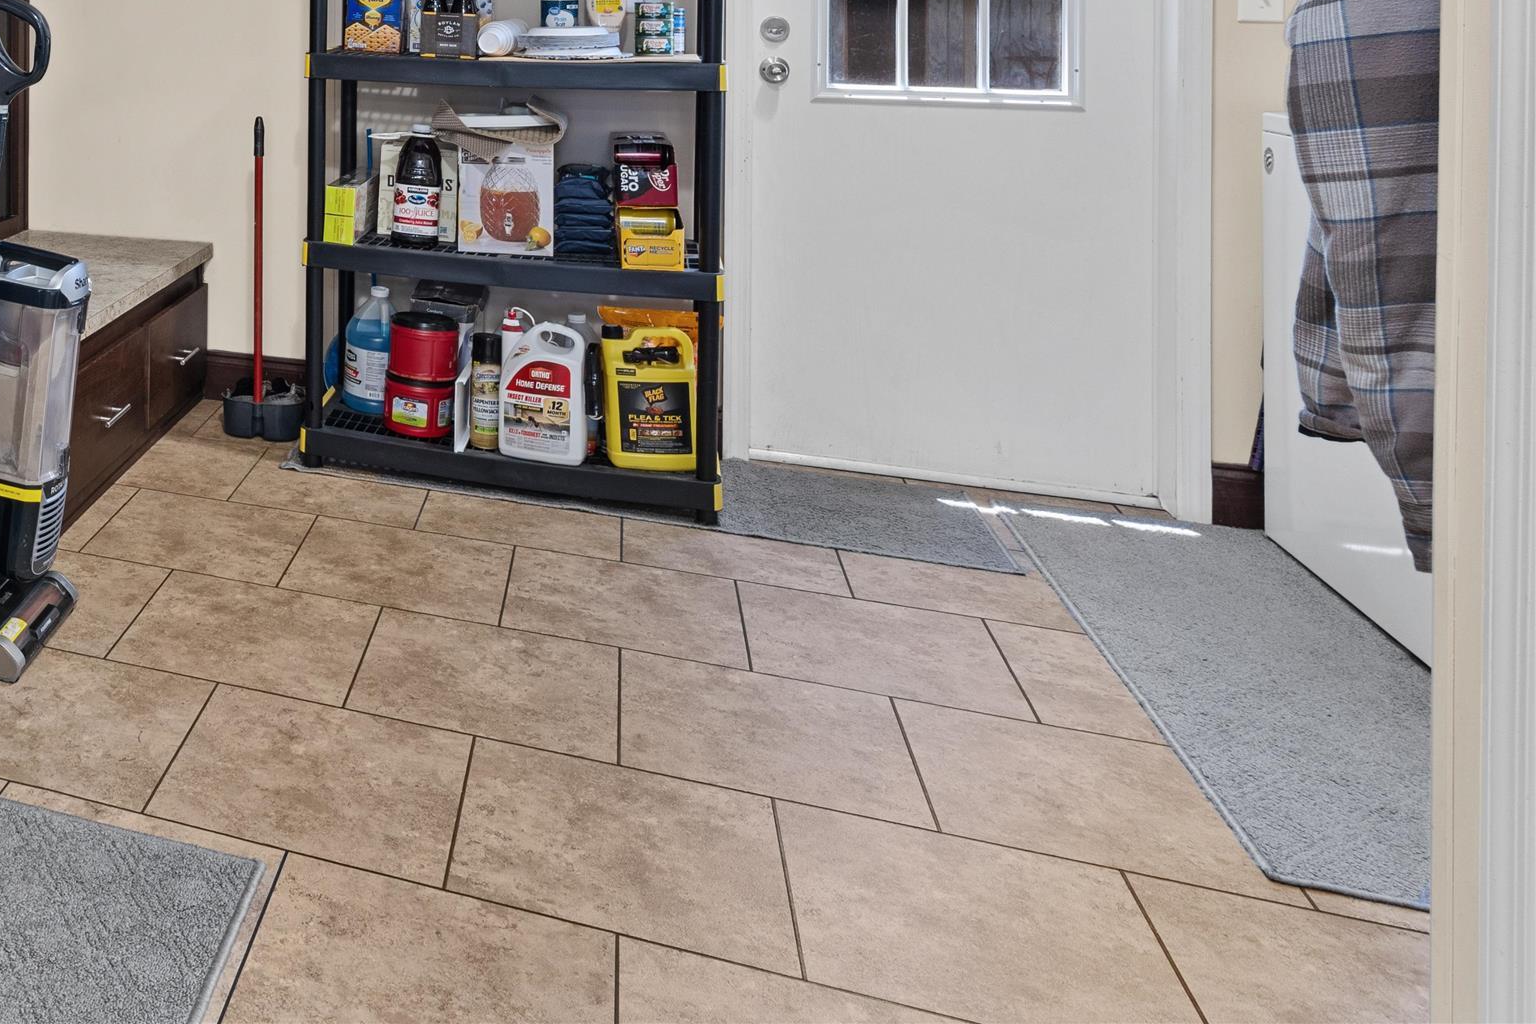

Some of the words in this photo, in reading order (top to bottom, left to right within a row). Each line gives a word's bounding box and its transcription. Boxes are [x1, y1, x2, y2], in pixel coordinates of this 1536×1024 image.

[620, 164, 629, 192] UGAR
[530, 370, 550, 379] ORTHO
[515, 379, 534, 389] HOME
[535, 381, 565, 392] DEFENSE
[644, 386, 663, 397] BLACK
[507, 392, 524, 400] INSECT
[525, 395, 542, 403] KILLER
[648, 394, 665, 402] FLAG
[551, 401, 563, 411] 12
